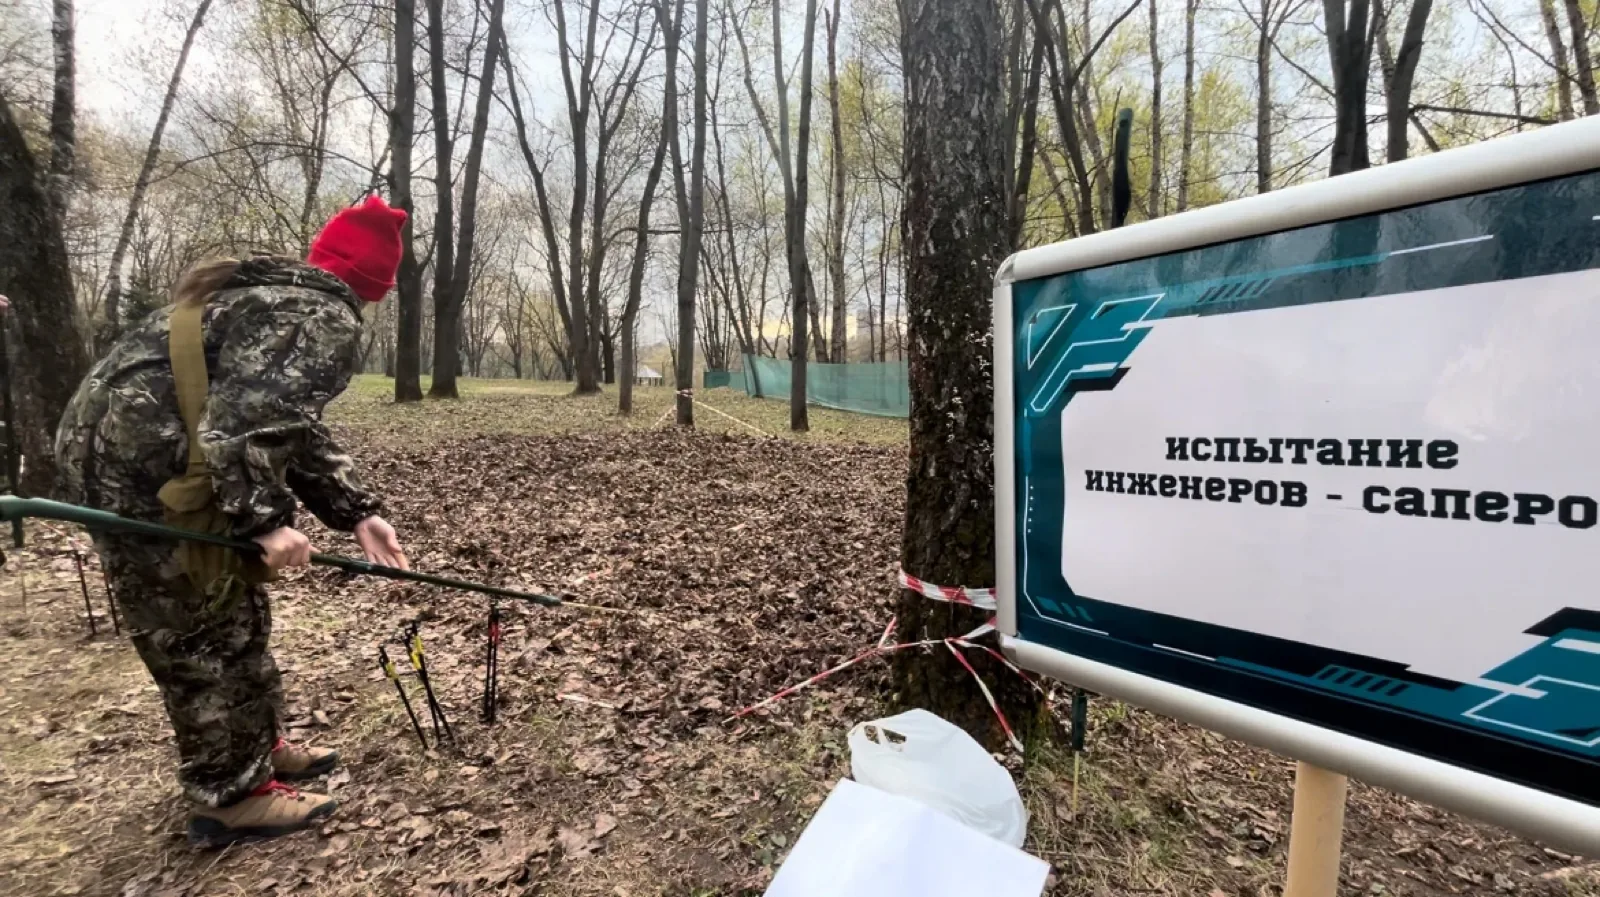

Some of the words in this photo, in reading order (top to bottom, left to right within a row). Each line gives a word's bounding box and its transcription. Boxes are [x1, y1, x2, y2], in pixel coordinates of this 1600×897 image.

[1165, 437, 1459, 470] испытание
[1085, 469, 1308, 508] инженеров
[1362, 485, 1598, 530] саперо
